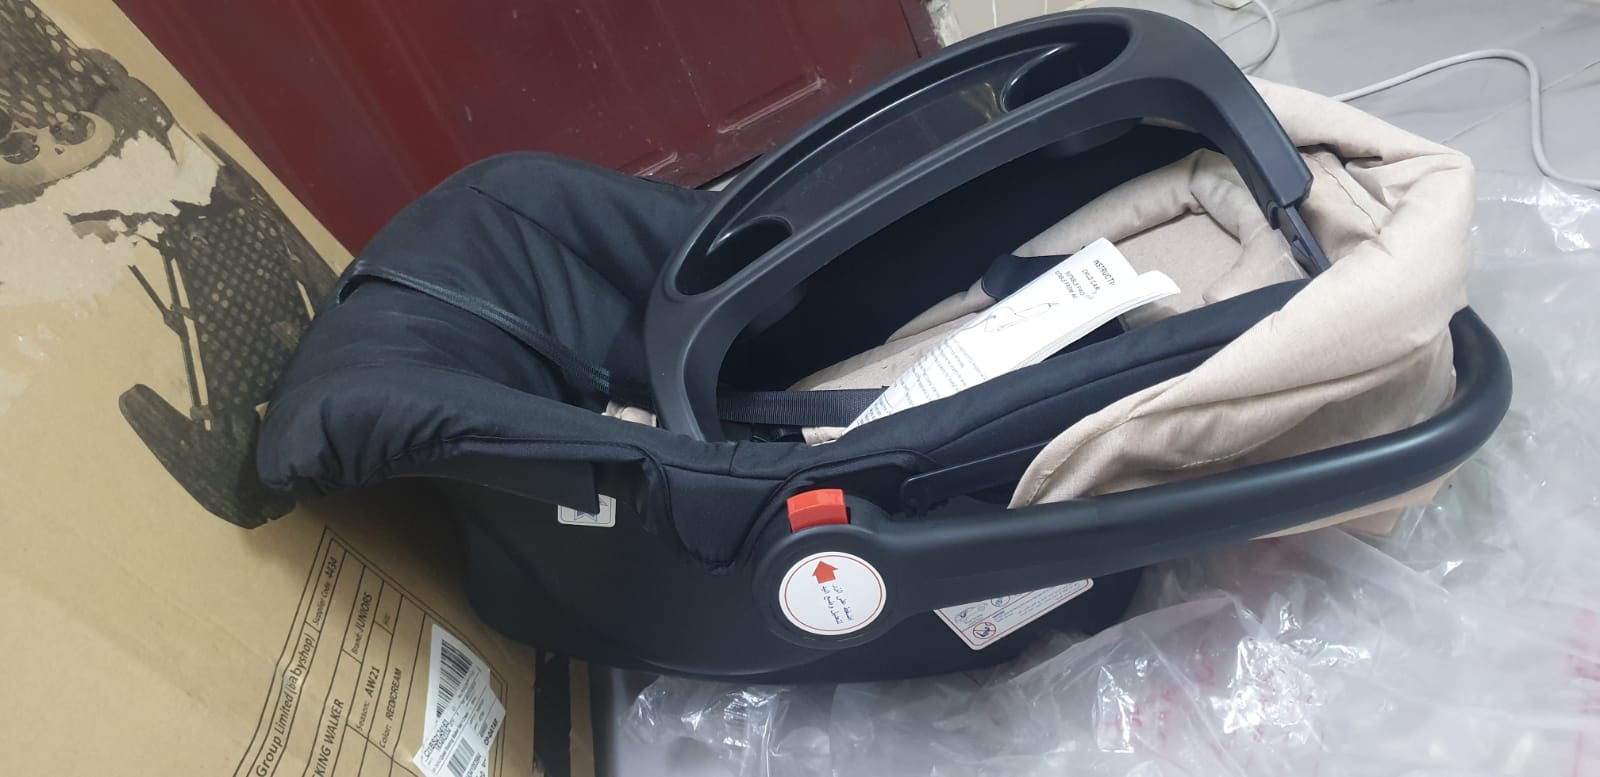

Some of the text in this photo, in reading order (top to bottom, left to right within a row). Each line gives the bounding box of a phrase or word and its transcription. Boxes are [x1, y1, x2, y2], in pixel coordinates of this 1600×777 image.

[324, 556, 338, 578] 4434
[355, 592, 373, 633] JUNIORS
[256, 633, 315, 777] Group Limited (babyshop)
[355, 665, 380, 731] Season: AW21
[385, 667, 402, 721] RED/CREAM
[312, 698, 345, 777] KING WALKER
